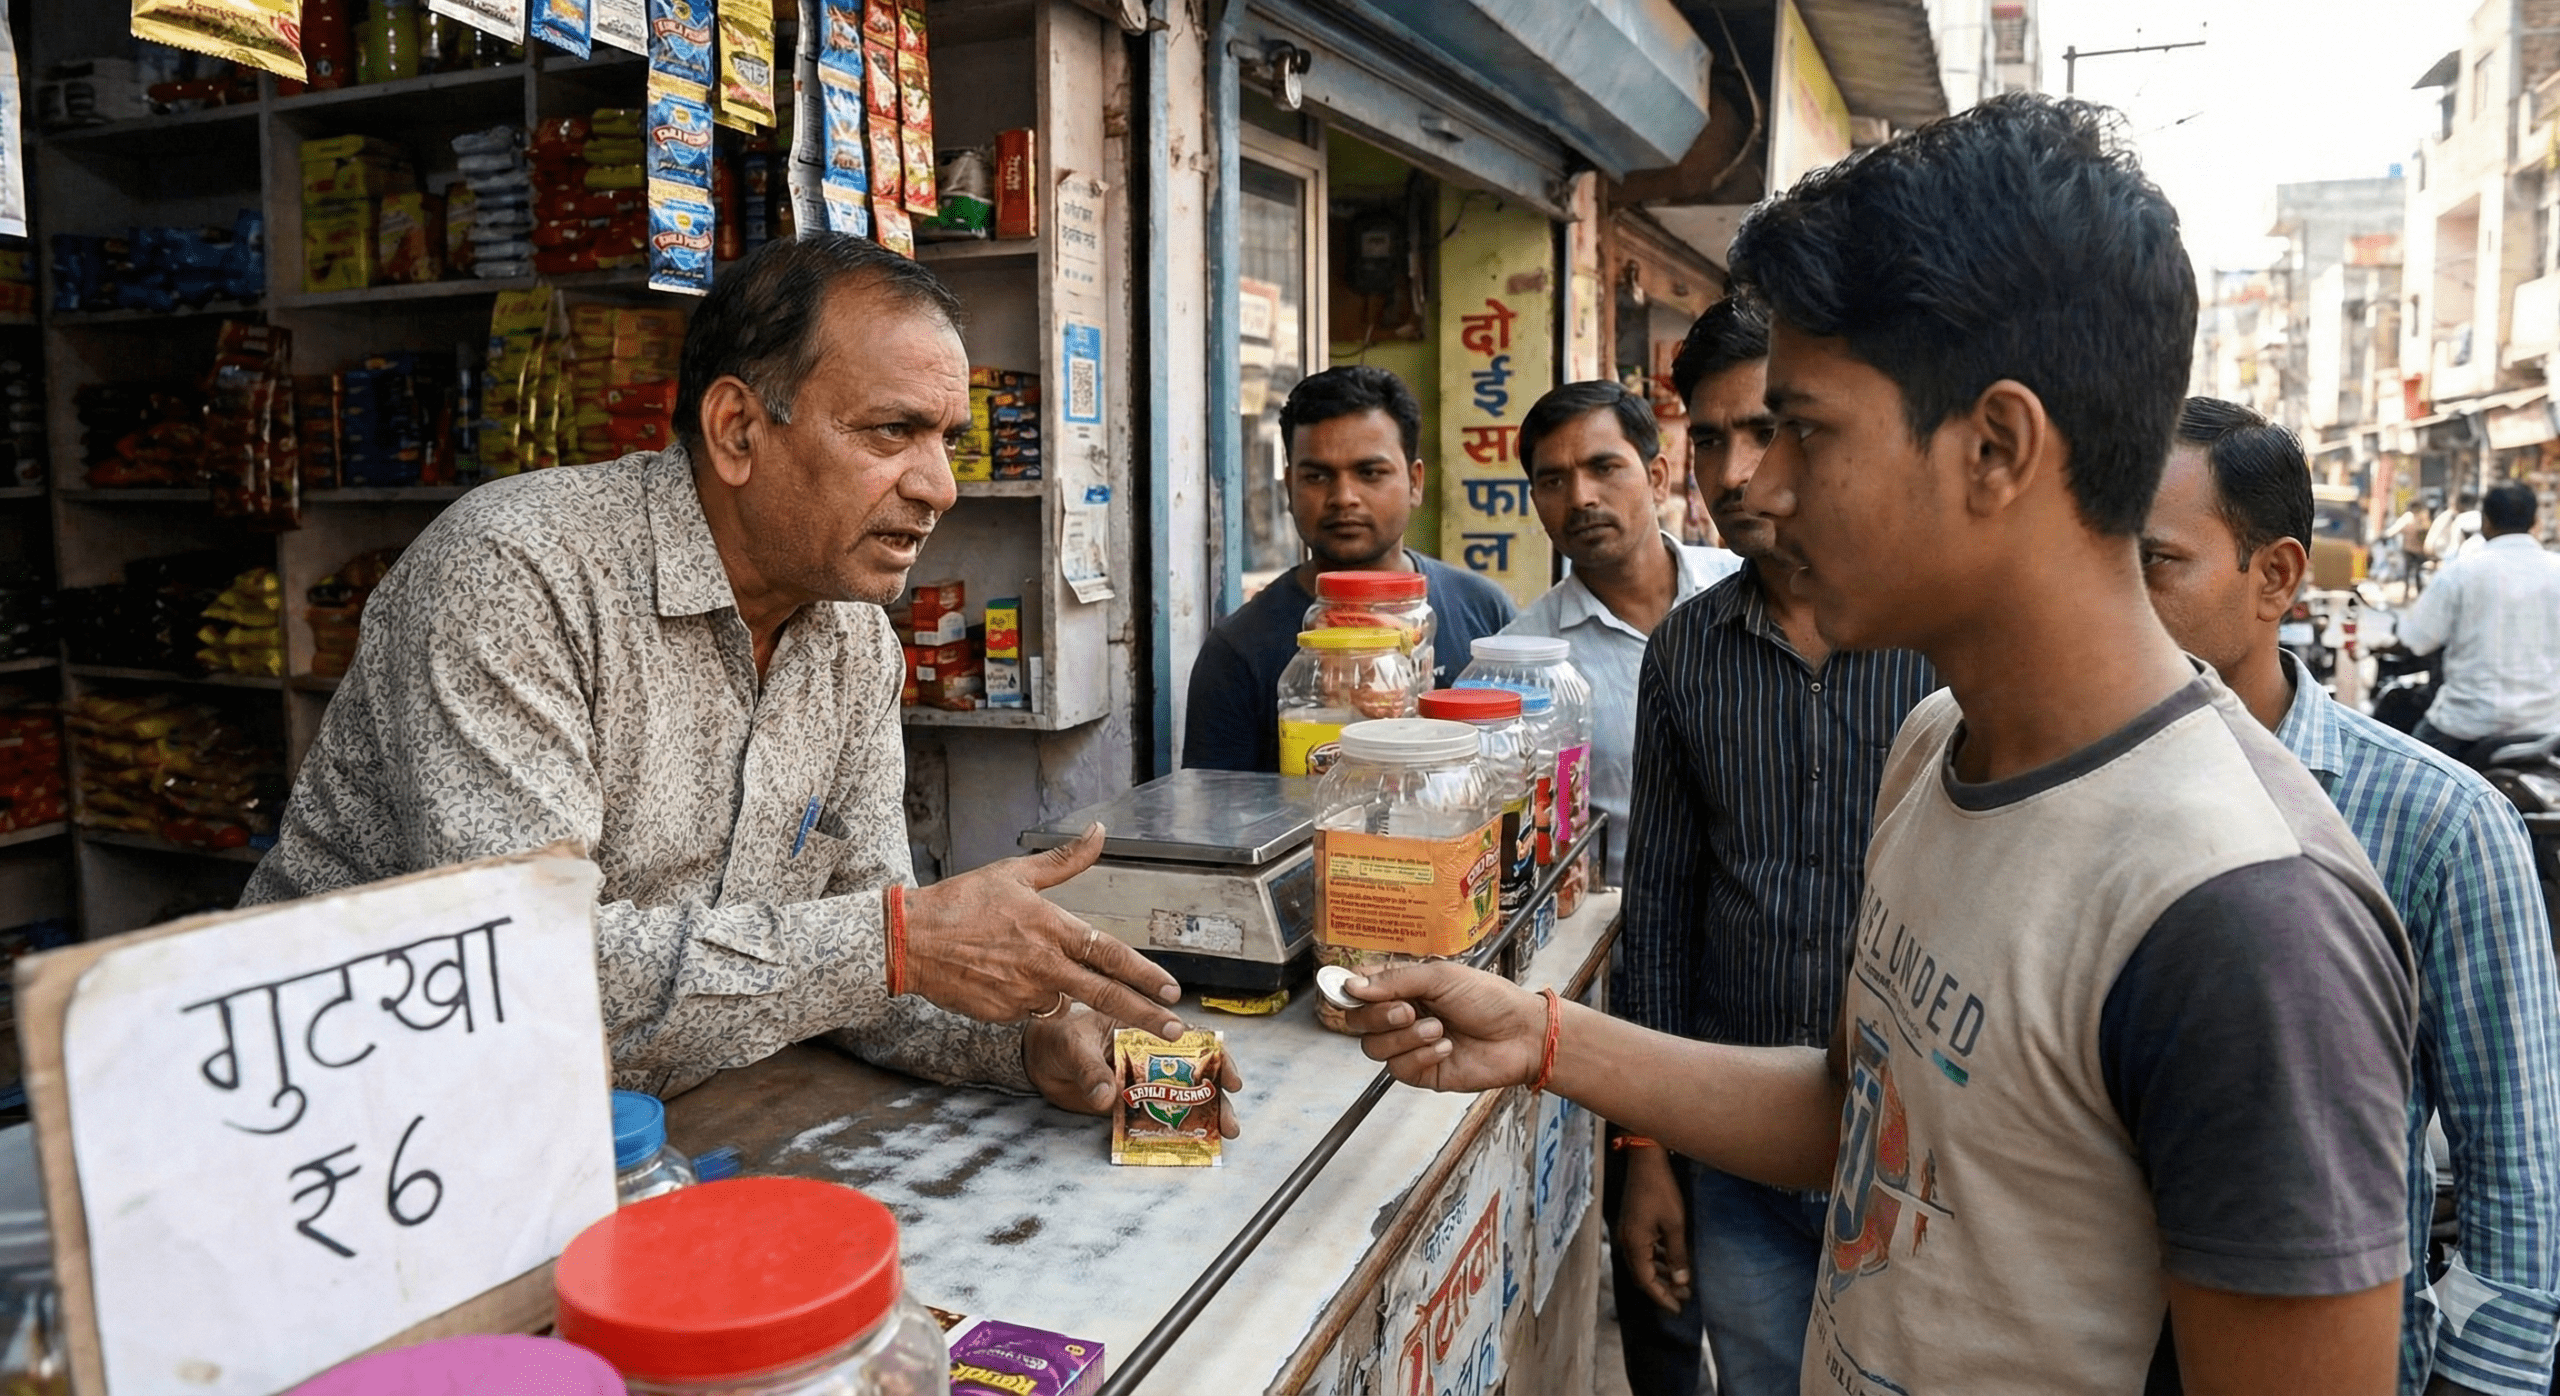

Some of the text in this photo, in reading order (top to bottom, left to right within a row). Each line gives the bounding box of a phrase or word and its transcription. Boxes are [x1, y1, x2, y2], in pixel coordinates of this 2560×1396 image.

[1461, 298, 1518, 358] दो
[1471, 355, 1515, 418] ई
[1461, 478, 1531, 517] फा
[1461, 532, 1517, 571] ल
[180, 916, 513, 1135] गुटखा
